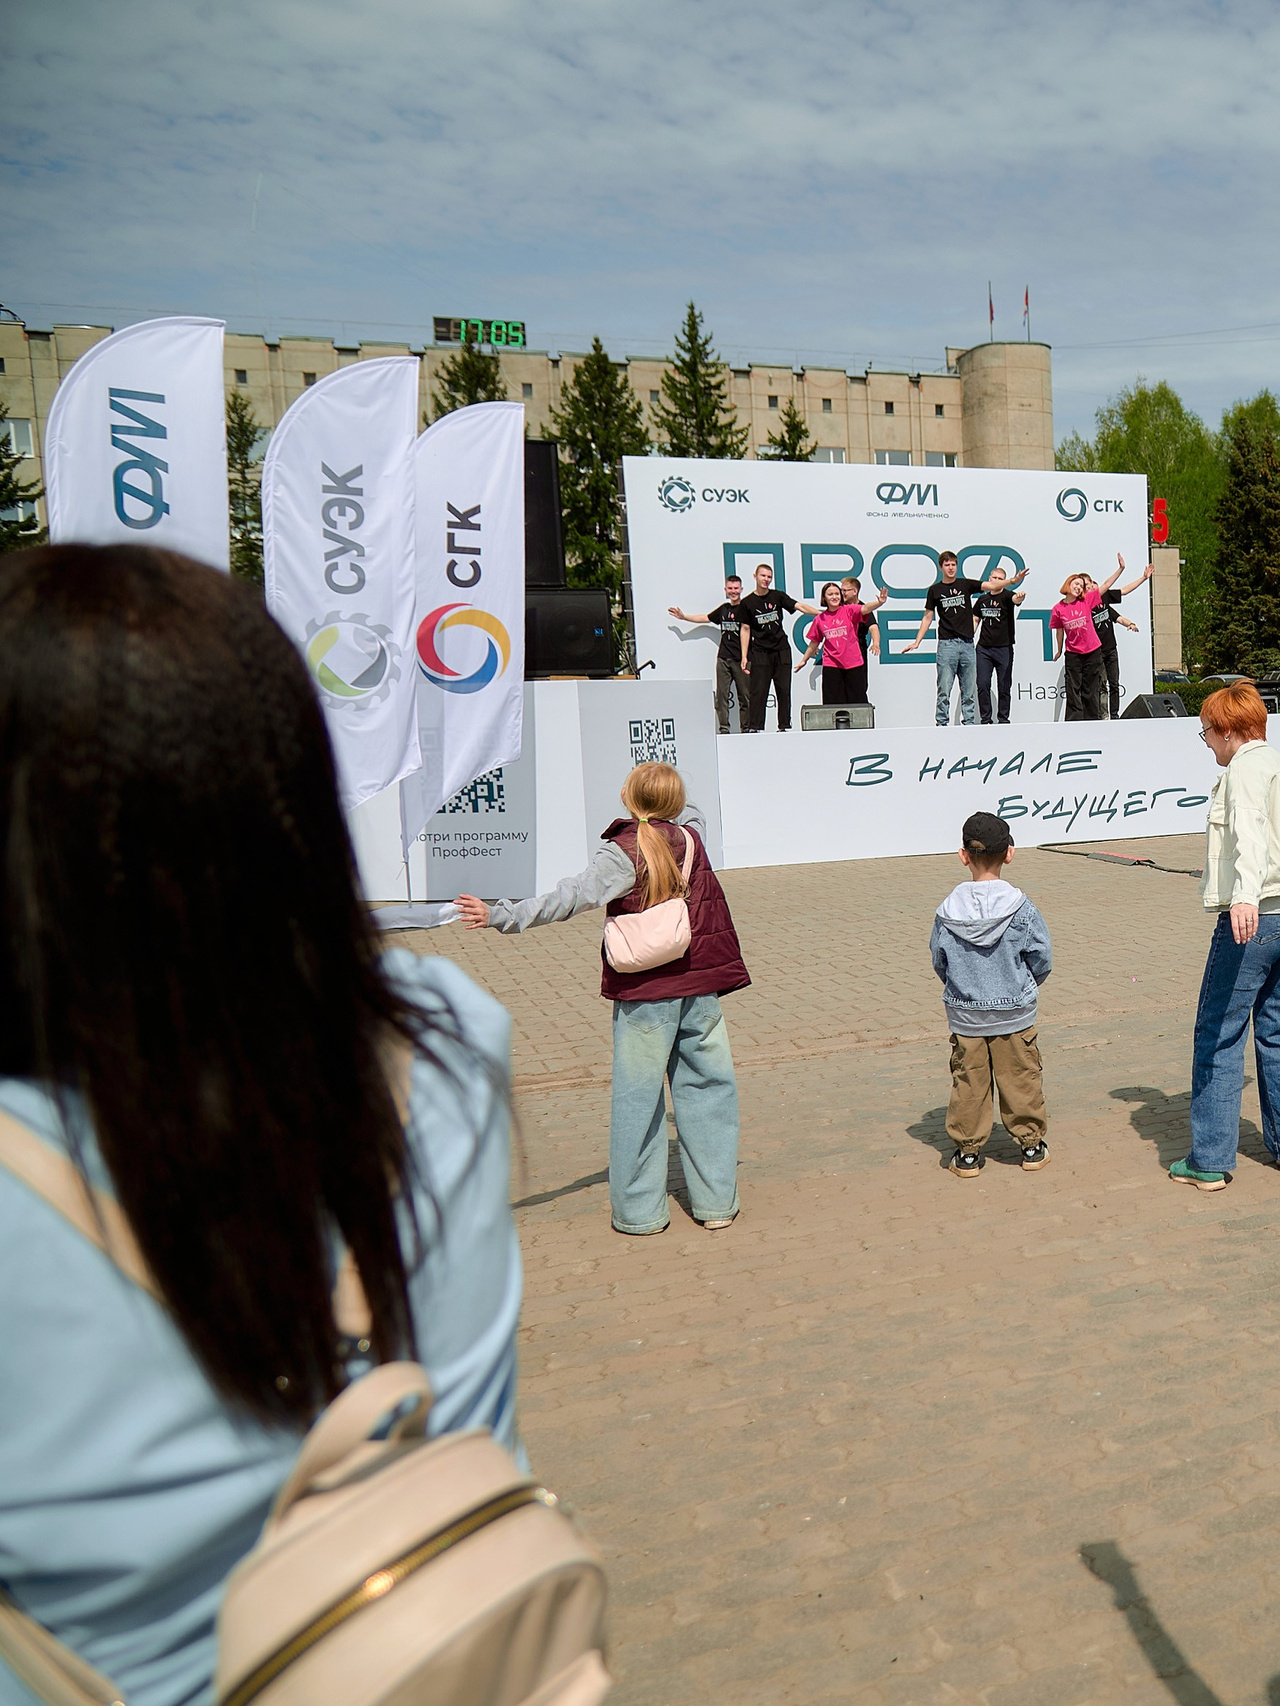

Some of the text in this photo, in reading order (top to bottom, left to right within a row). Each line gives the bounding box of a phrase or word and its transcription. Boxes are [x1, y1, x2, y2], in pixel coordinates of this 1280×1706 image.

[701, 488, 751, 503] СУЭК
[1093, 499, 1125, 513] СГК
[321, 461, 366, 594] СУЭК
[446, 501, 481, 588] СГК
[722, 542, 1026, 600] ПРОФ
[845, 750, 1103, 787] В НАЧАЛЕ
[997, 788, 1209, 833] БУДУЩЕГО
[432, 846, 503, 860] ПрофФест
[454, 832, 529, 844] программу
